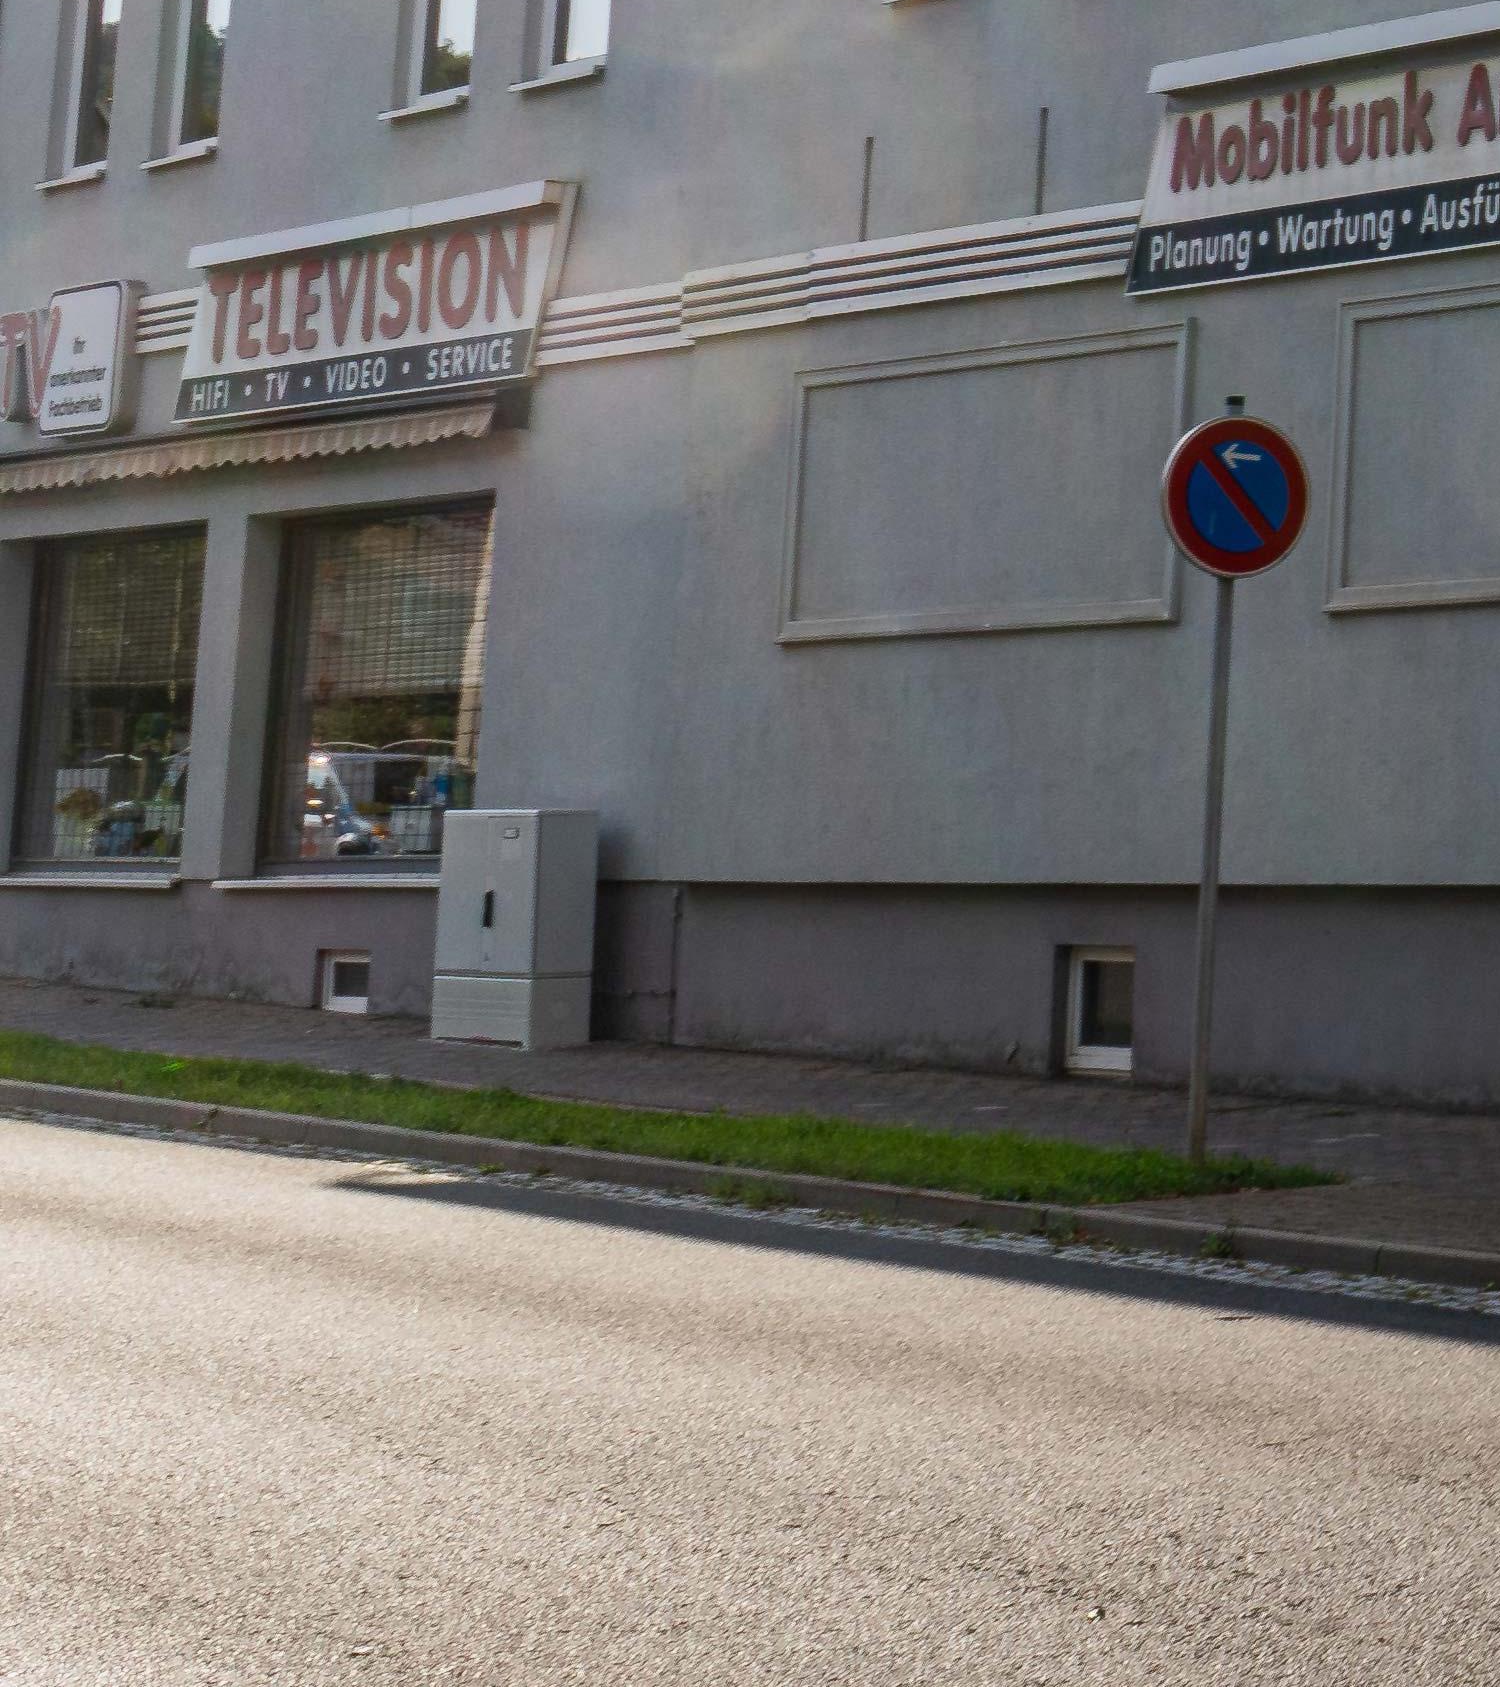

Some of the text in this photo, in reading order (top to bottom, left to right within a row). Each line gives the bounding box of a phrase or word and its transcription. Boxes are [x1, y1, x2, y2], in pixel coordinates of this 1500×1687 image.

[1170, 69, 1435, 193] Mobilfunk
[209, 221, 529, 364] TELEVISION
[1149, 227, 1252, 273] Planung
[1277, 206, 1395, 254] Wartung
[0, 306, 62, 420] TV
[189, 336, 513, 412] HIFI TV VIDEO SERVICE
